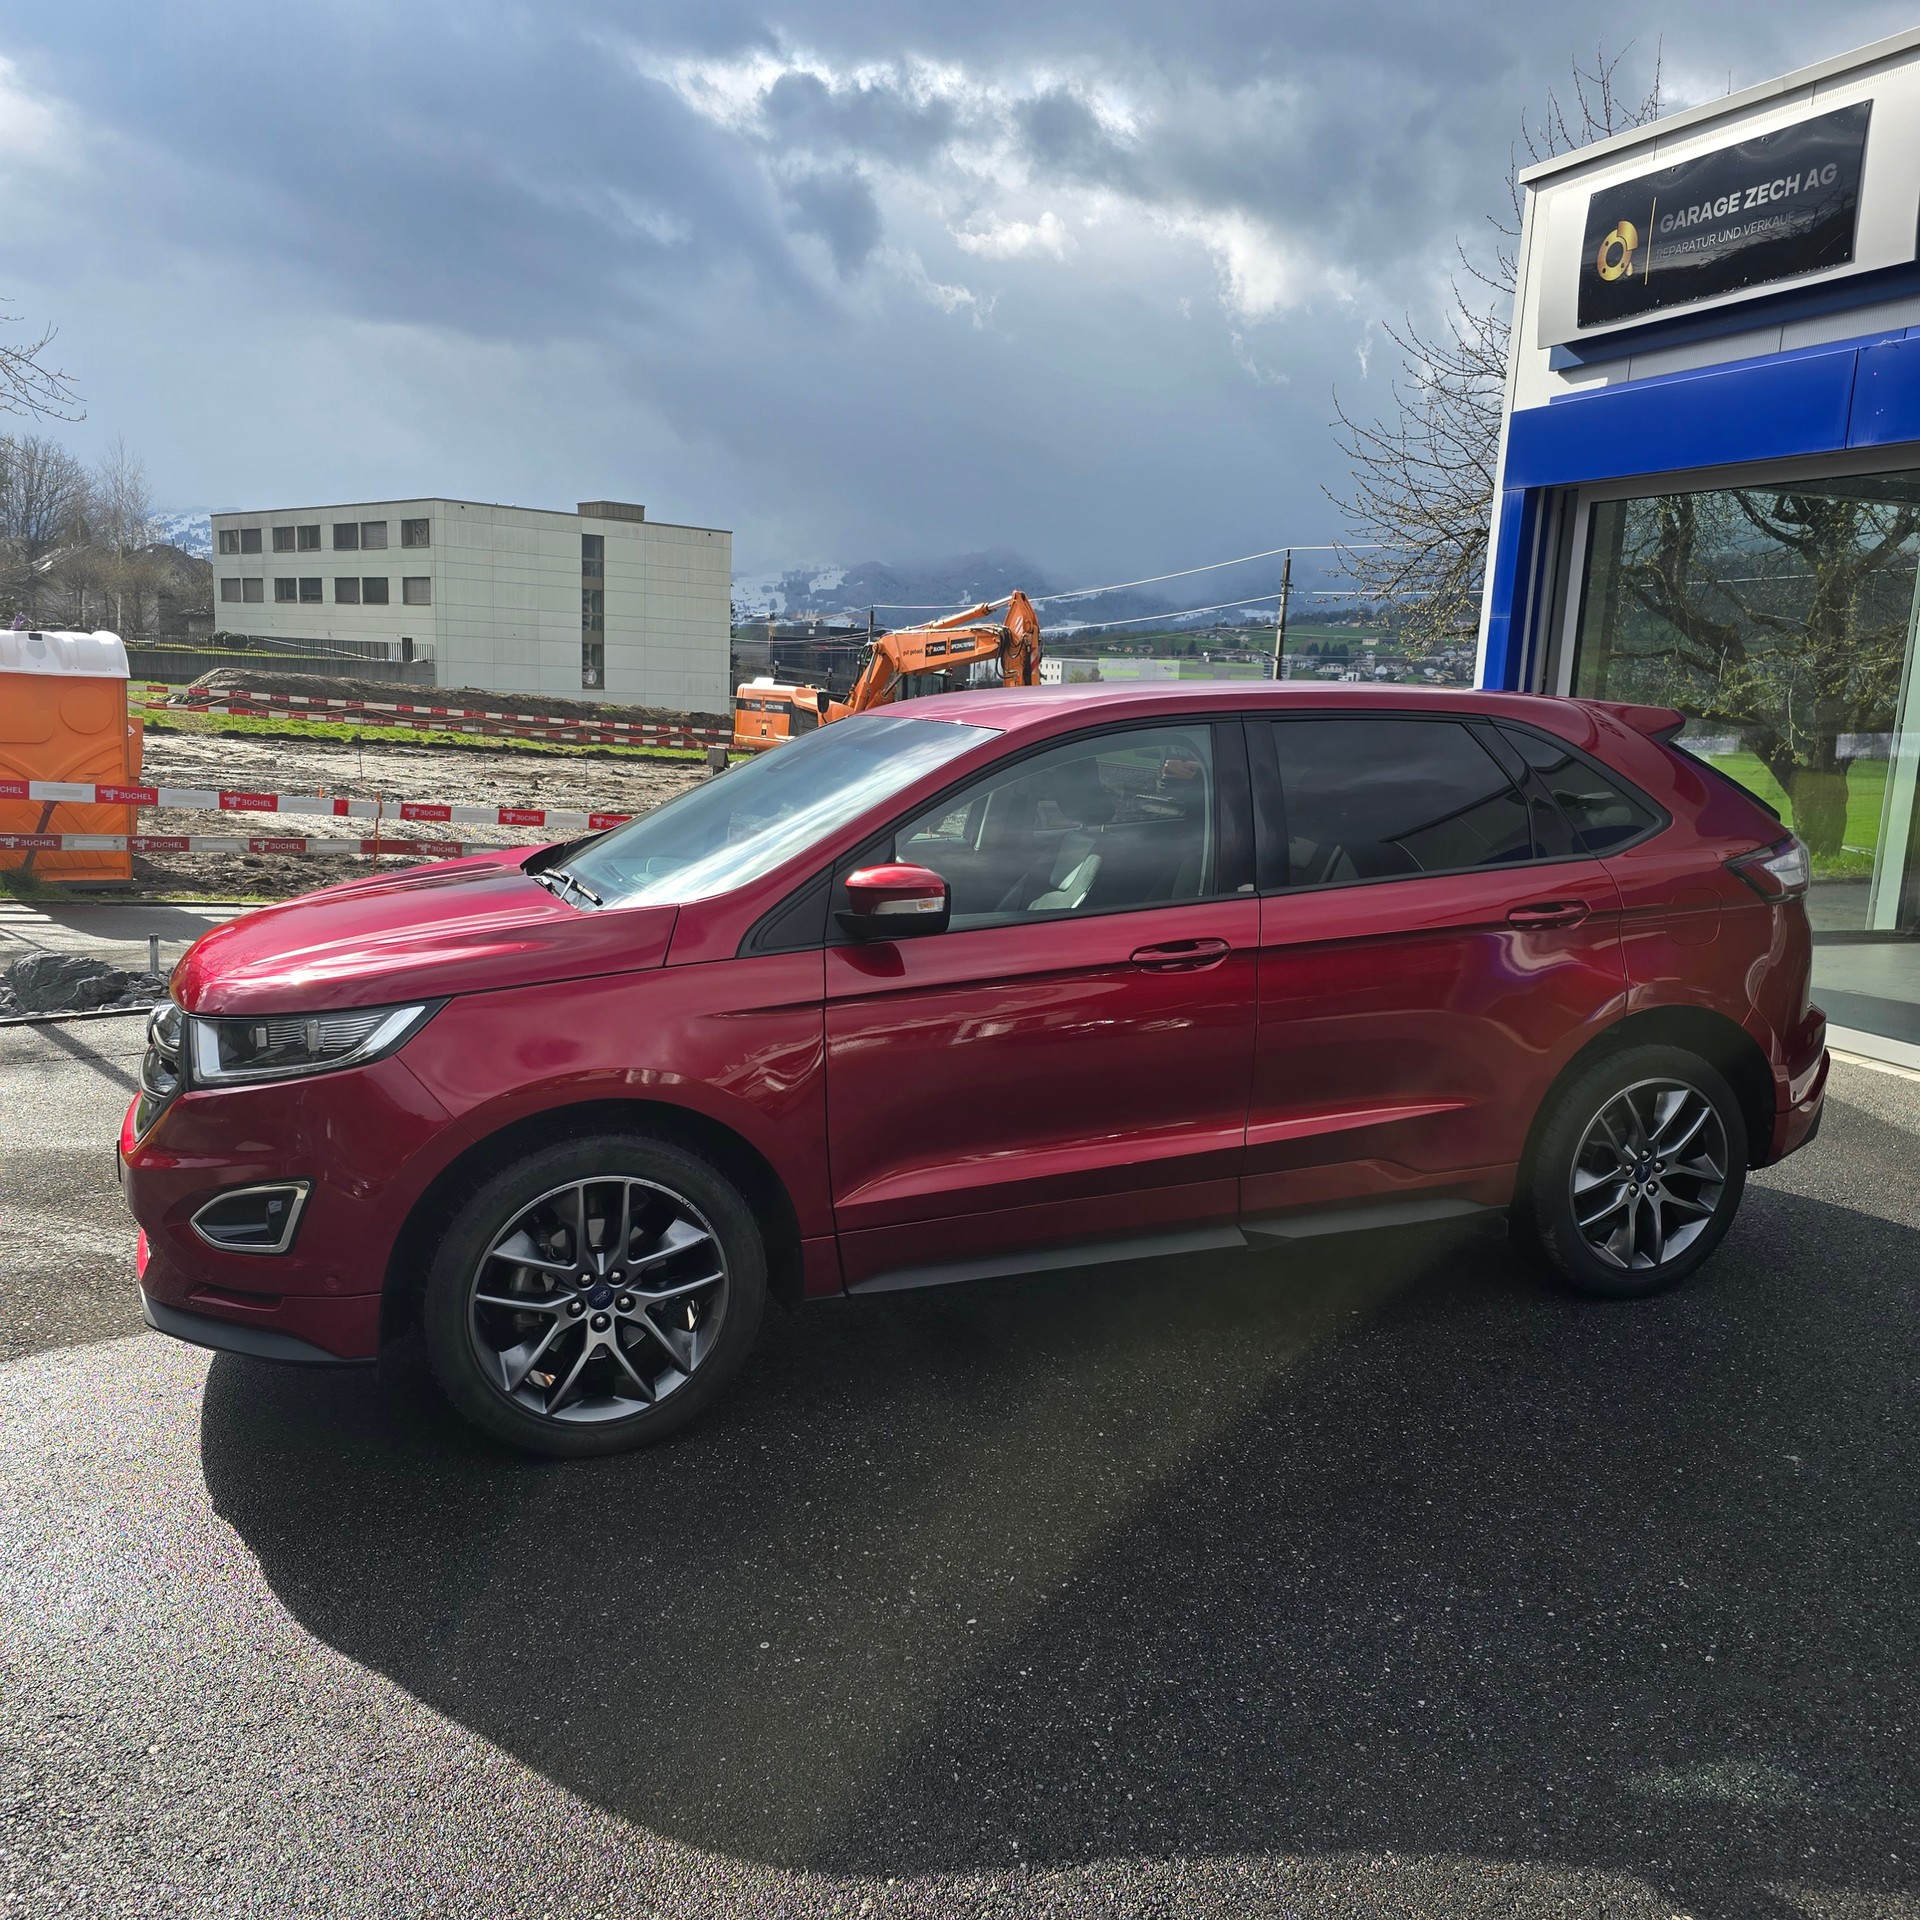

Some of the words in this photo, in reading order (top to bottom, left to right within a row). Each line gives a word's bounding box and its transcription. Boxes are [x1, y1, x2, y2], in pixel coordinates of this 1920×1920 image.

[1659, 191, 1741, 233] GARAGE
[1743, 173, 1801, 210] ZECH
[1803, 163, 1838, 192] AG
[1656, 233, 1716, 260] REPARATUR
[1718, 227, 1741, 243] UND
[1743, 211, 1795, 235] VERKAUF
